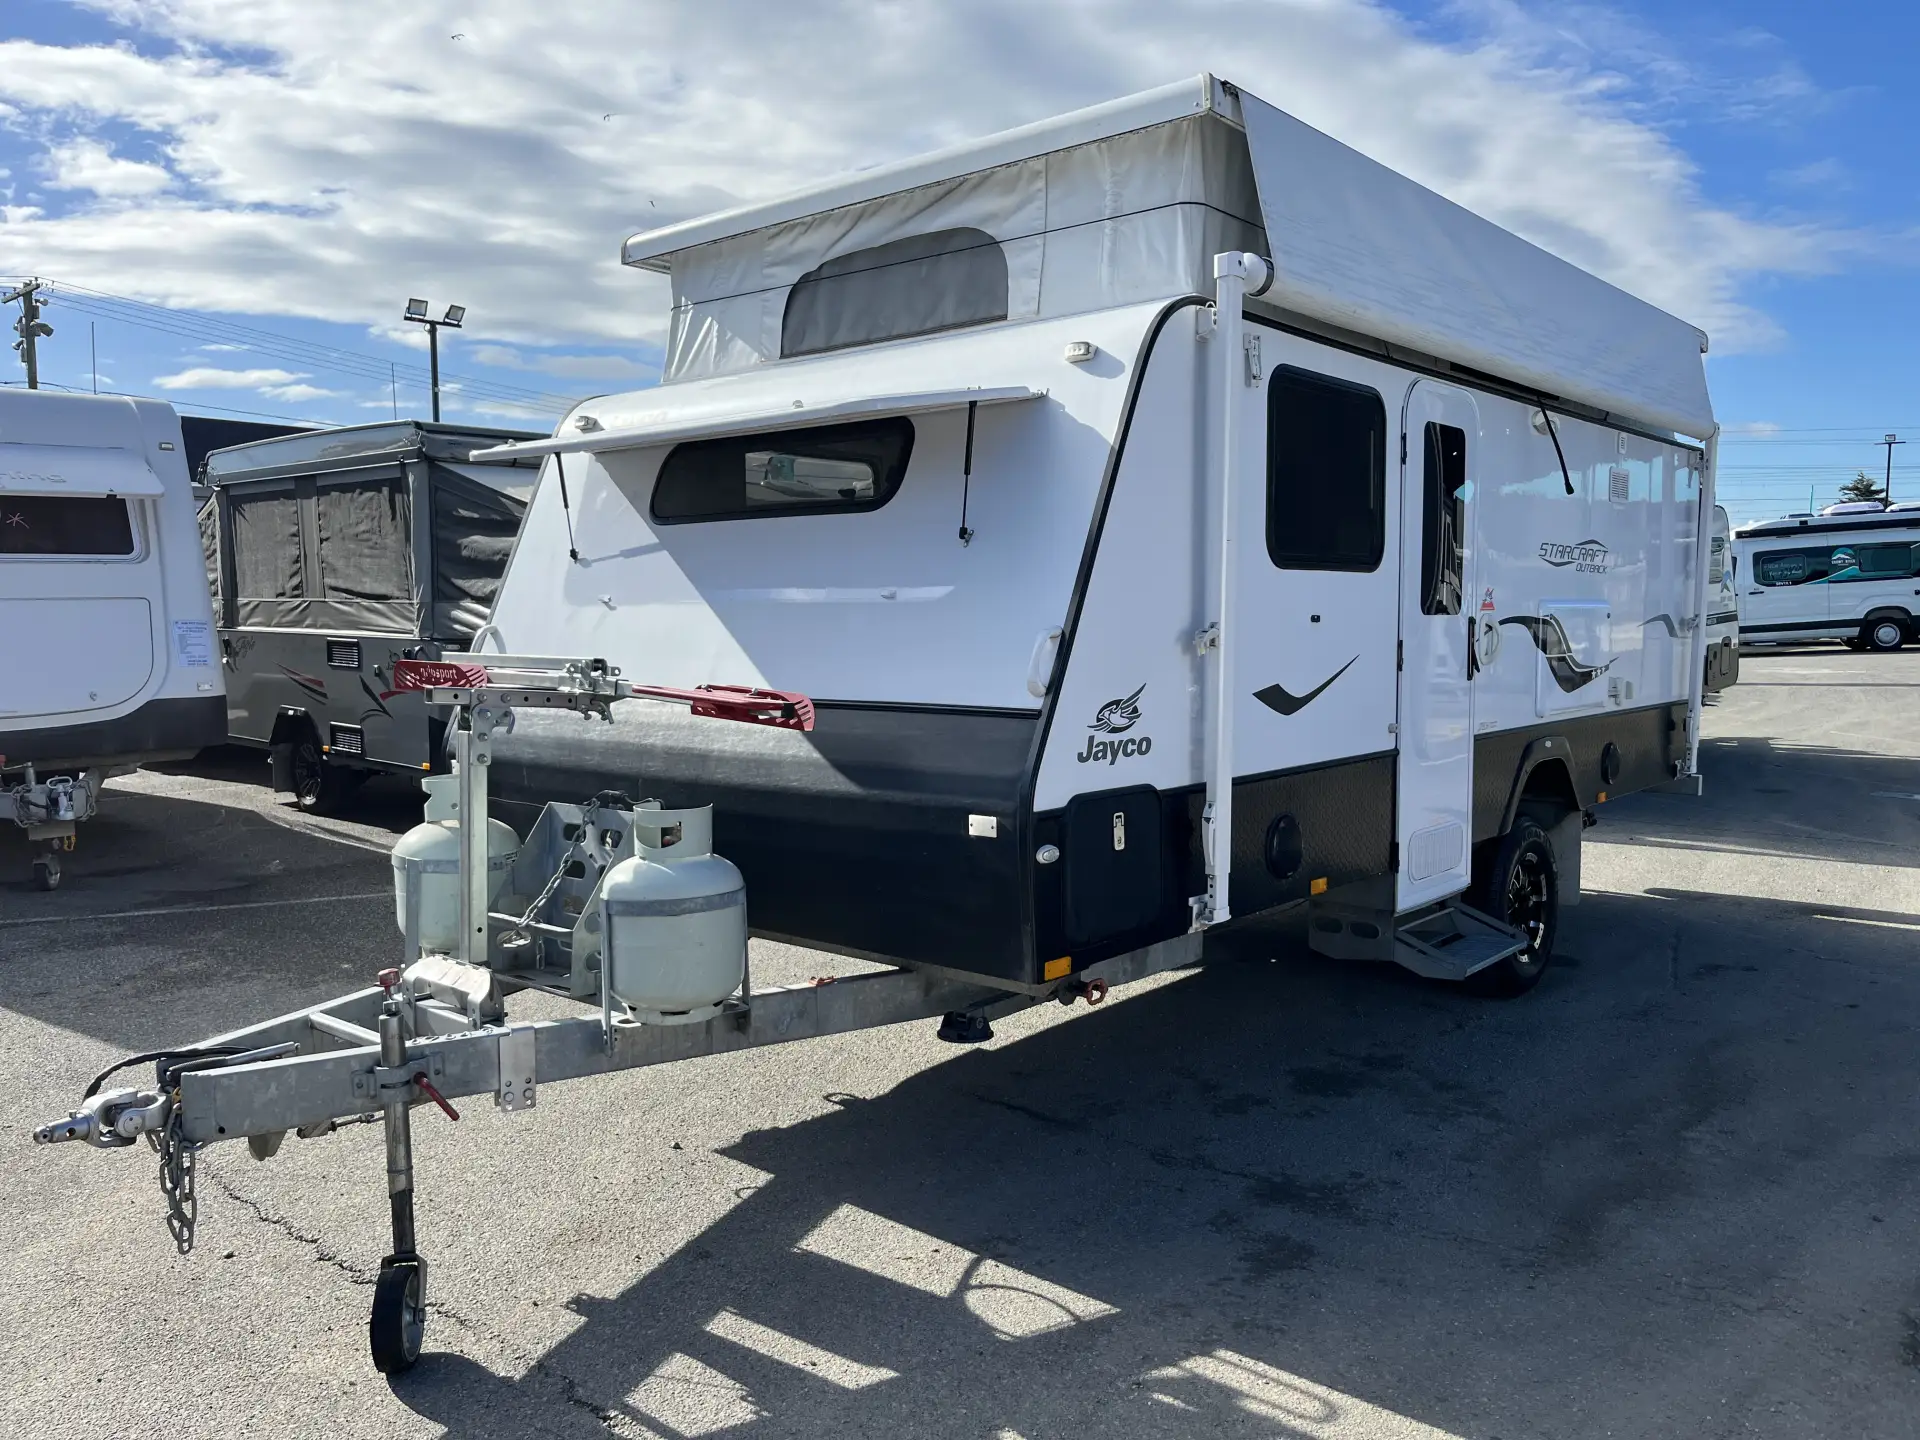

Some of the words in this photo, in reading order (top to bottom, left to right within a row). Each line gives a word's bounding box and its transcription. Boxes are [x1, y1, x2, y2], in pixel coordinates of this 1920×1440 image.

[1538, 543, 1608, 563] STARCRAFT
[1576, 563, 1607, 574] OUTBACK
[1077, 735, 1151, 766] Jayco
